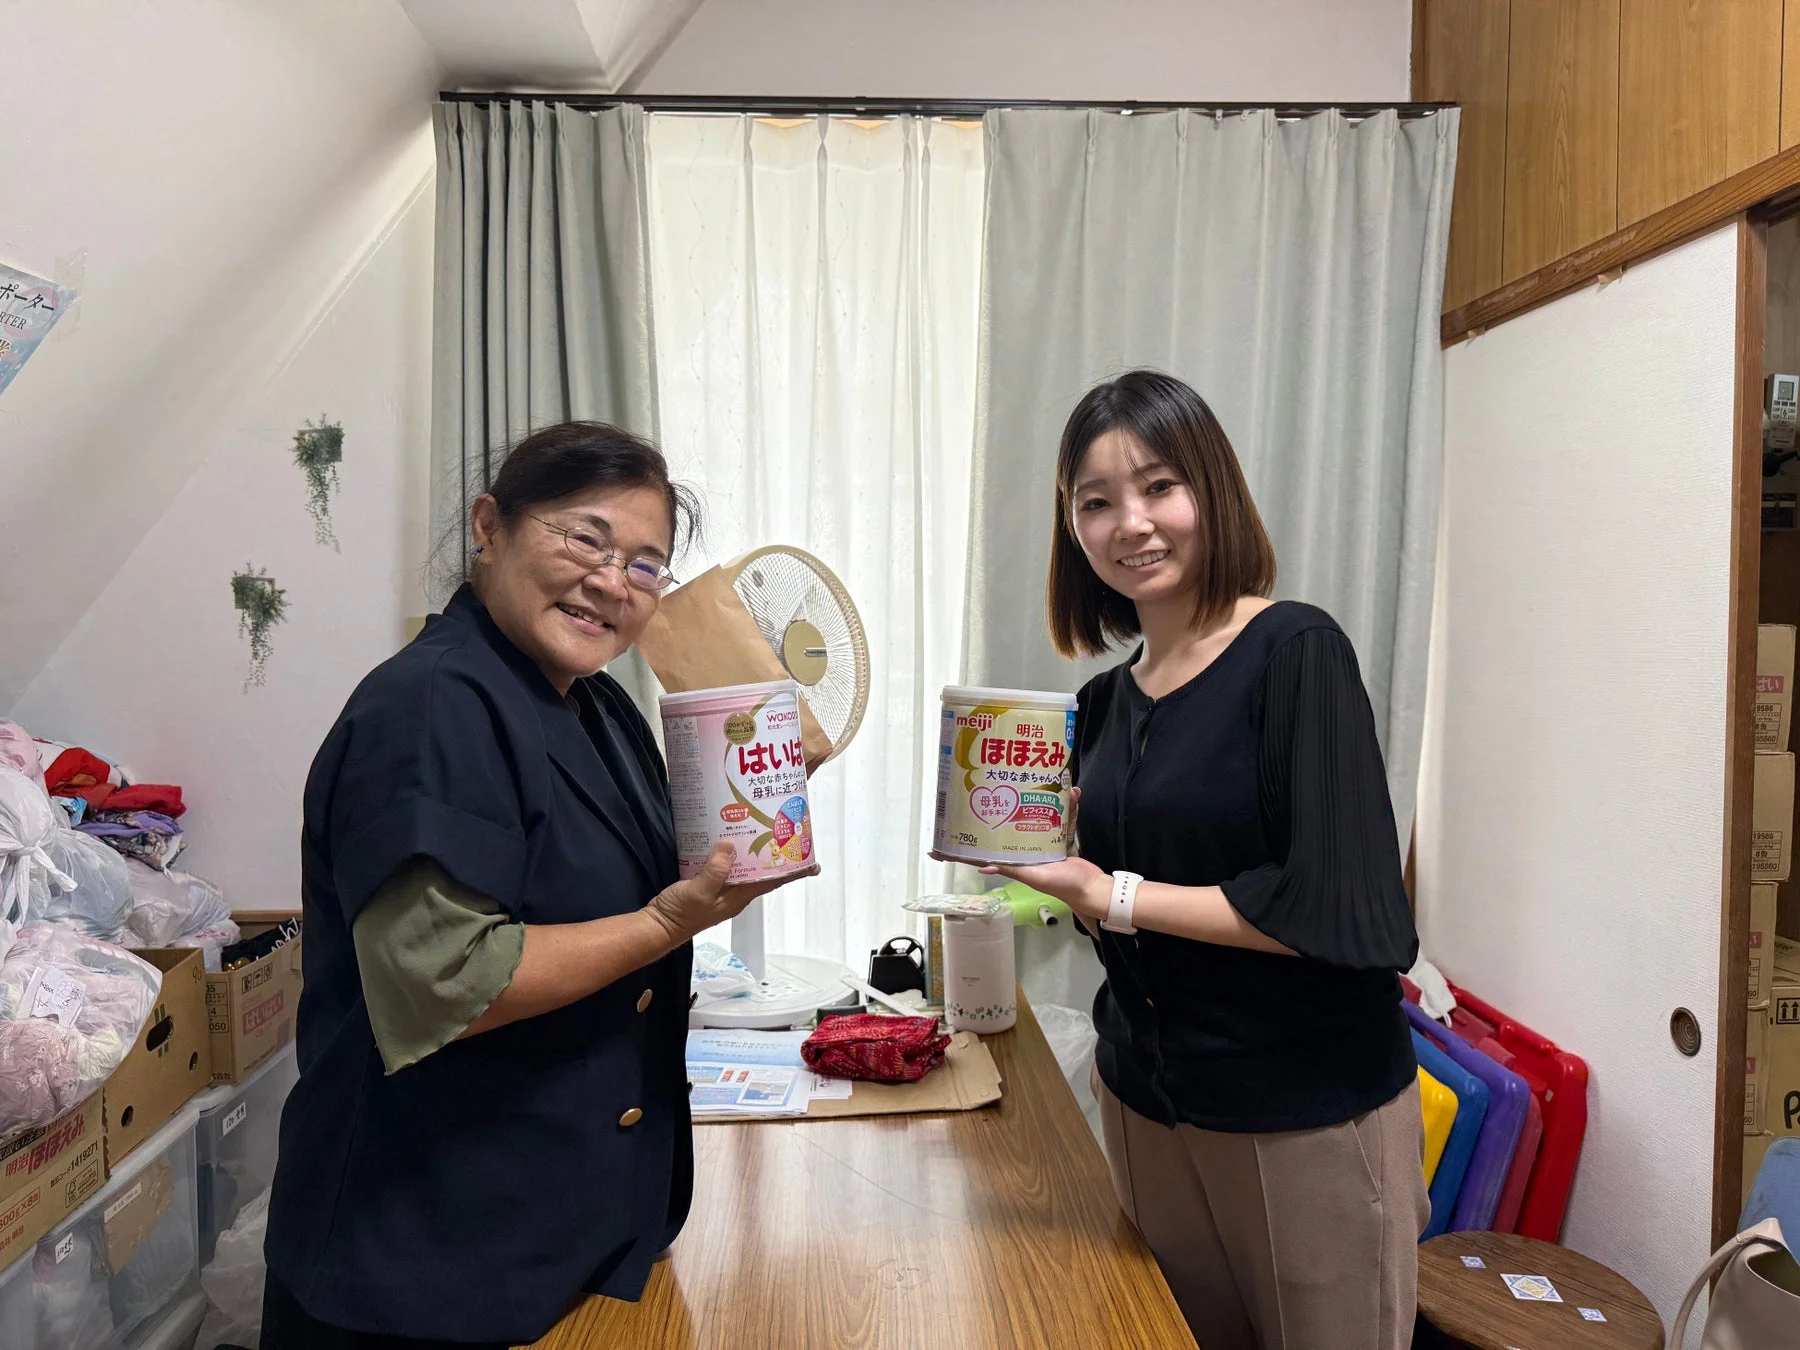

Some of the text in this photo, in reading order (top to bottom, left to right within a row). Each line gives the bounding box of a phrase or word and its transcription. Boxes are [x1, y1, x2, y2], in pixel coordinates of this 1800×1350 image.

[0, 283, 54, 311] ポーター
[956, 714, 993, 731] meiji
[1016, 724, 1044, 738] 明治
[980, 738, 1066, 768] ほほえみ
[985, 769, 1060, 784] 大切な赤ちゃんへ
[980, 795, 1010, 808] 母乳を
